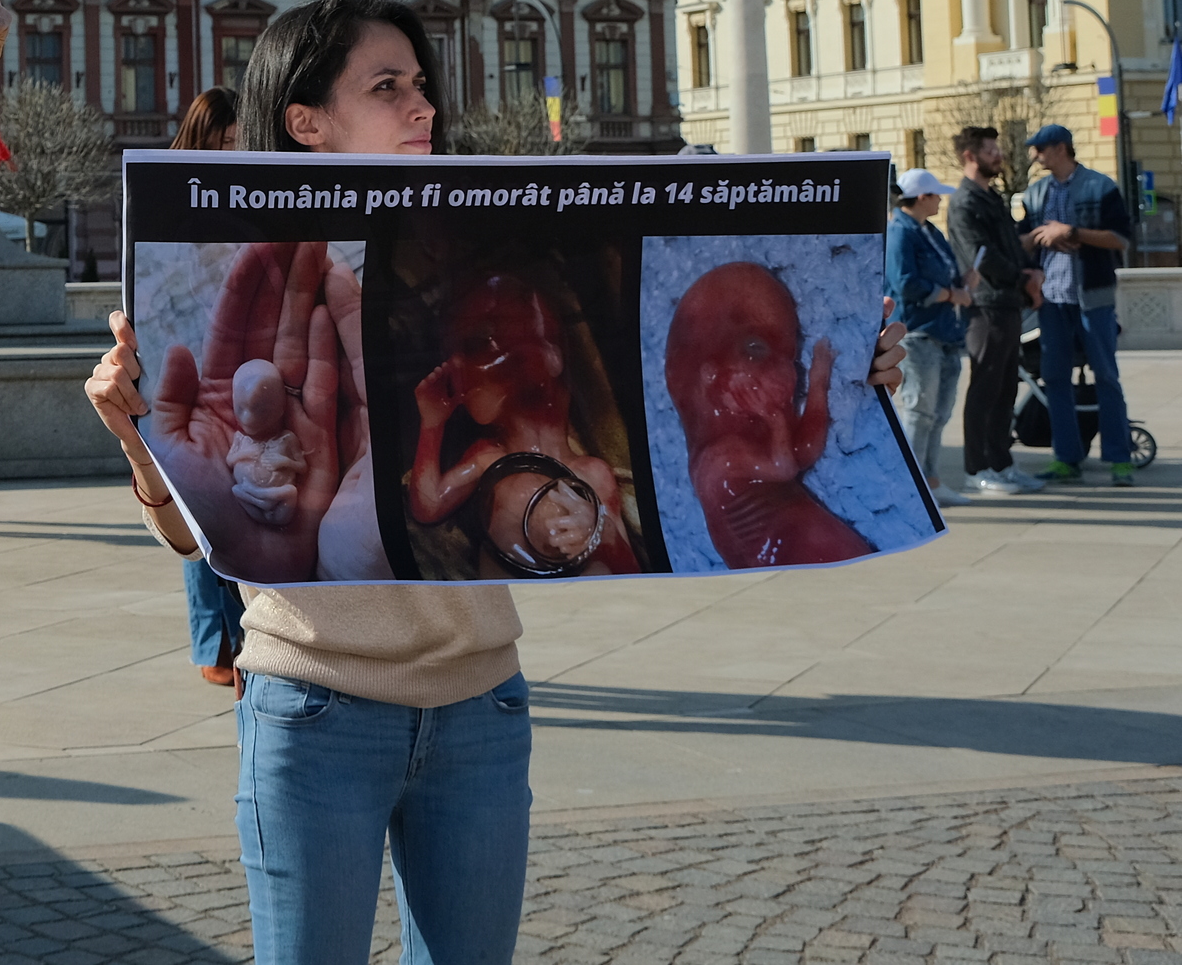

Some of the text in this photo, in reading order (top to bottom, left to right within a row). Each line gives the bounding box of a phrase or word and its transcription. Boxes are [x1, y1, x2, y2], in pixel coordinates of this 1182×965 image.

[187, 177, 840, 215] În România pot fi omorât până la 14 săptămâni
